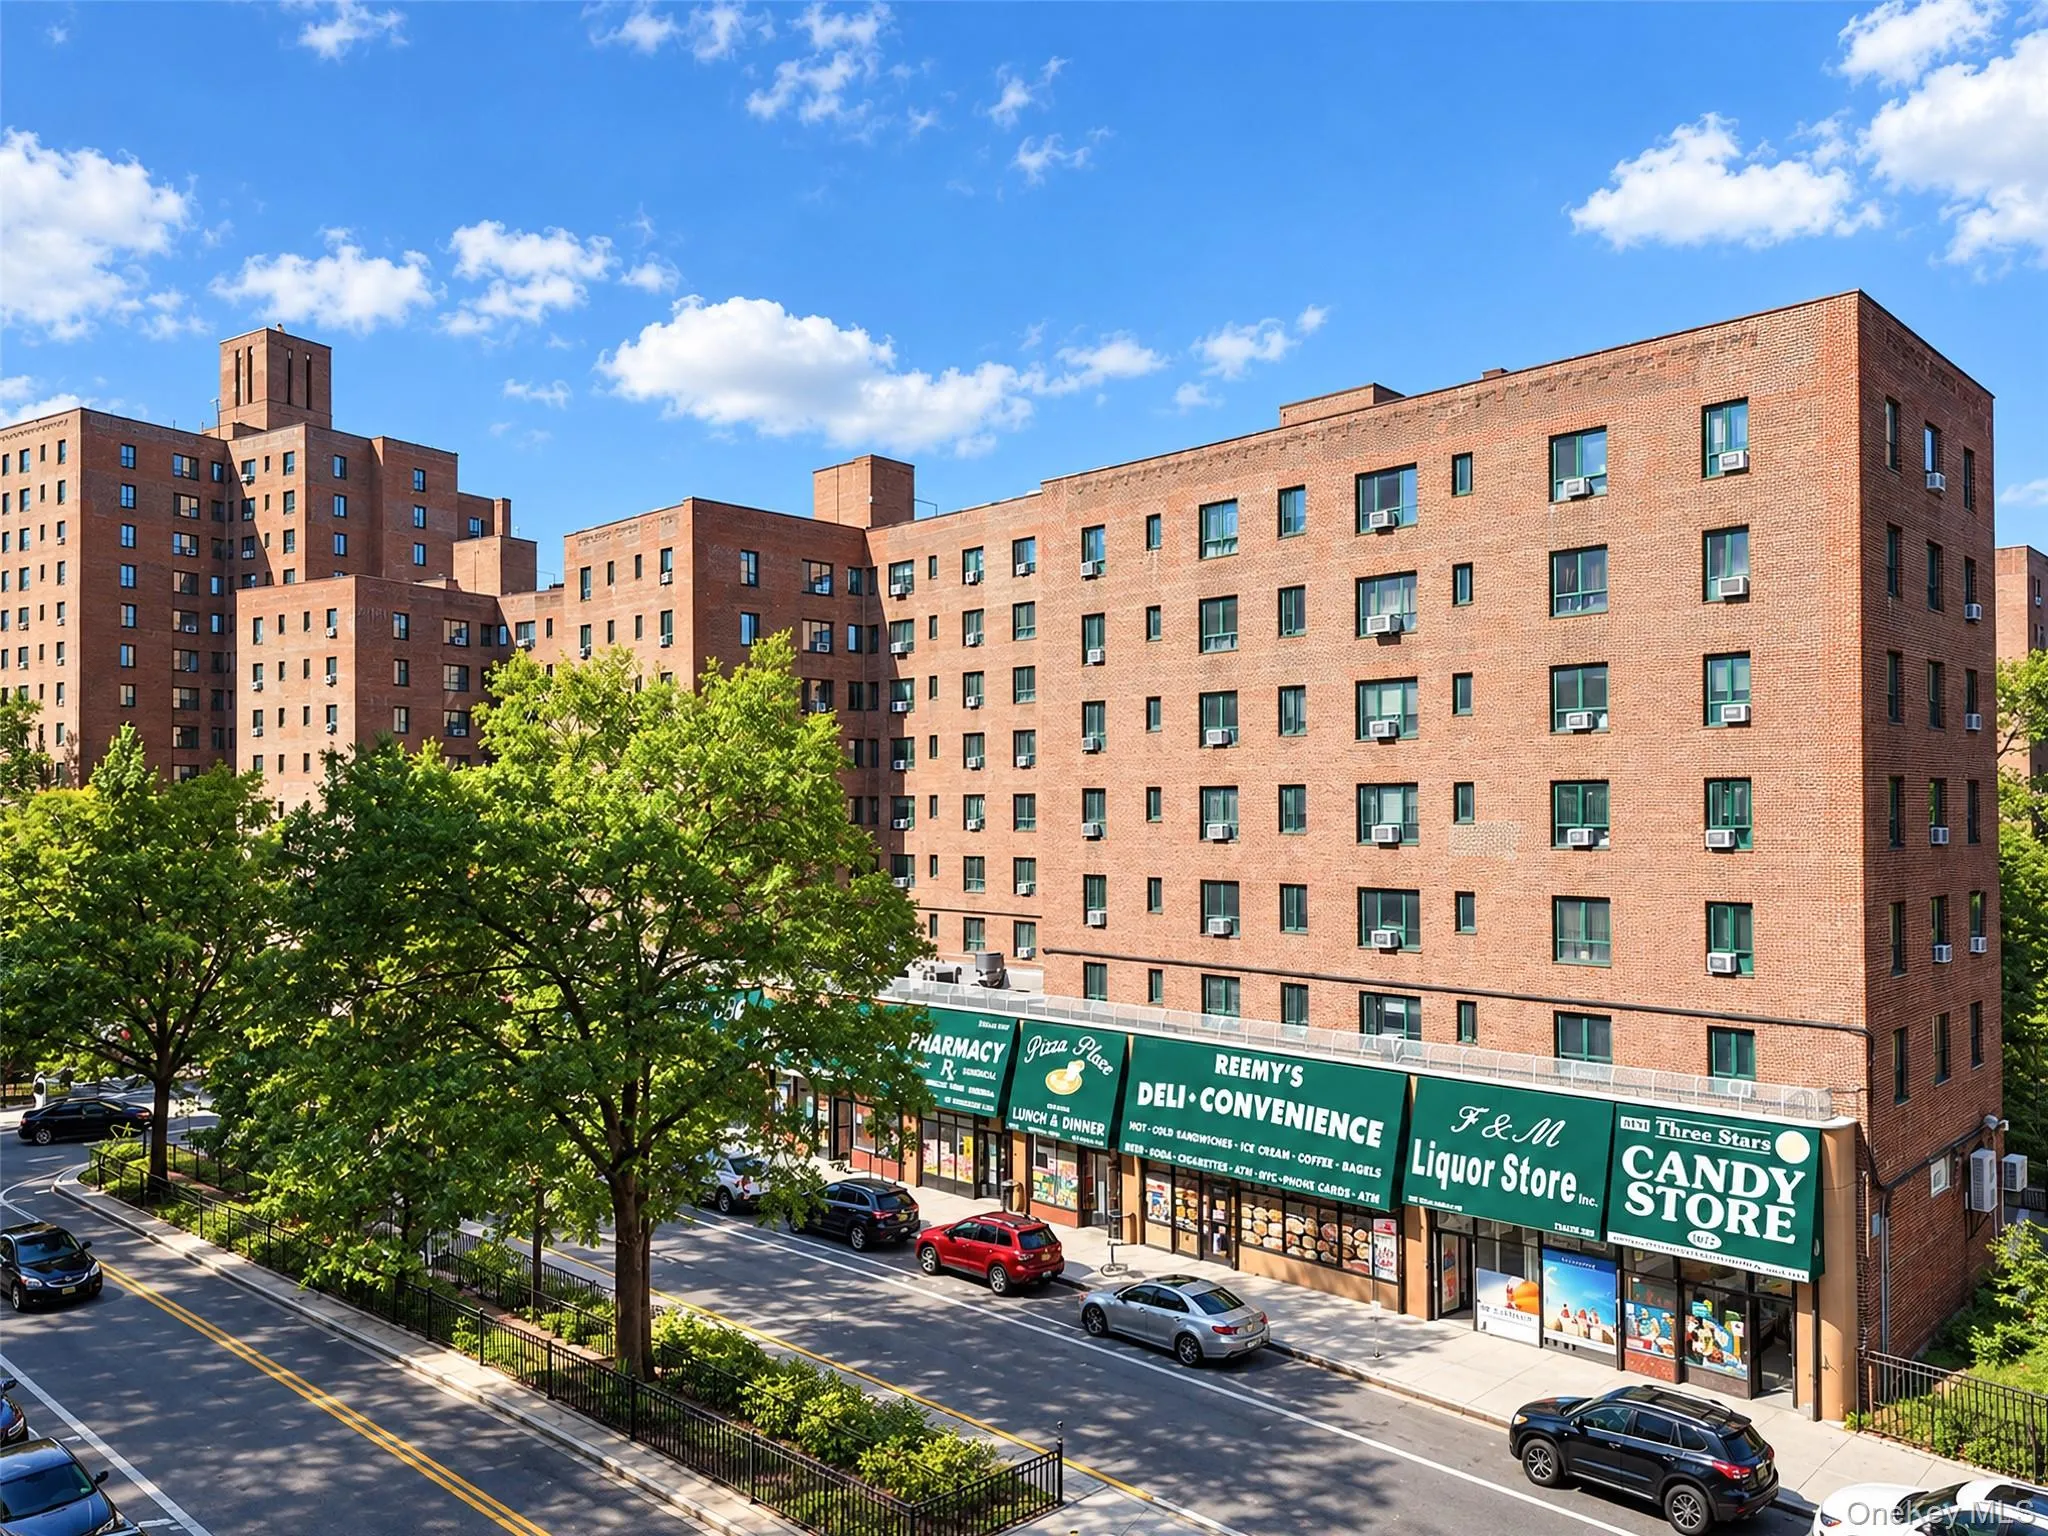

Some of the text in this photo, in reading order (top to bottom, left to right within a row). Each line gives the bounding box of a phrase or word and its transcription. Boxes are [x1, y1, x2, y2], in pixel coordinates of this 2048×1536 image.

[907, 1031, 1006, 1064] PHARMACY
[1024, 1035, 1069, 1063] Pizza
[1214, 1053, 1304, 1088] REEMY'S
[1012, 1107, 1047, 1125] LUNCH
[1062, 1116, 1105, 1136] DINNER
[1137, 1081, 1385, 1149] DELI CONVENIENCE
[1450, 1105, 1566, 1148] F & M
[1655, 1119, 1712, 1143] Three
[1718, 1129, 1771, 1151] Stars
[1342, 1161, 1382, 1178] BAGELS
[1411, 1138, 1599, 1208] Liquor Store Inc.
[1621, 1145, 1806, 1205] CANDY
[1624, 1181, 1797, 1245] STORE
